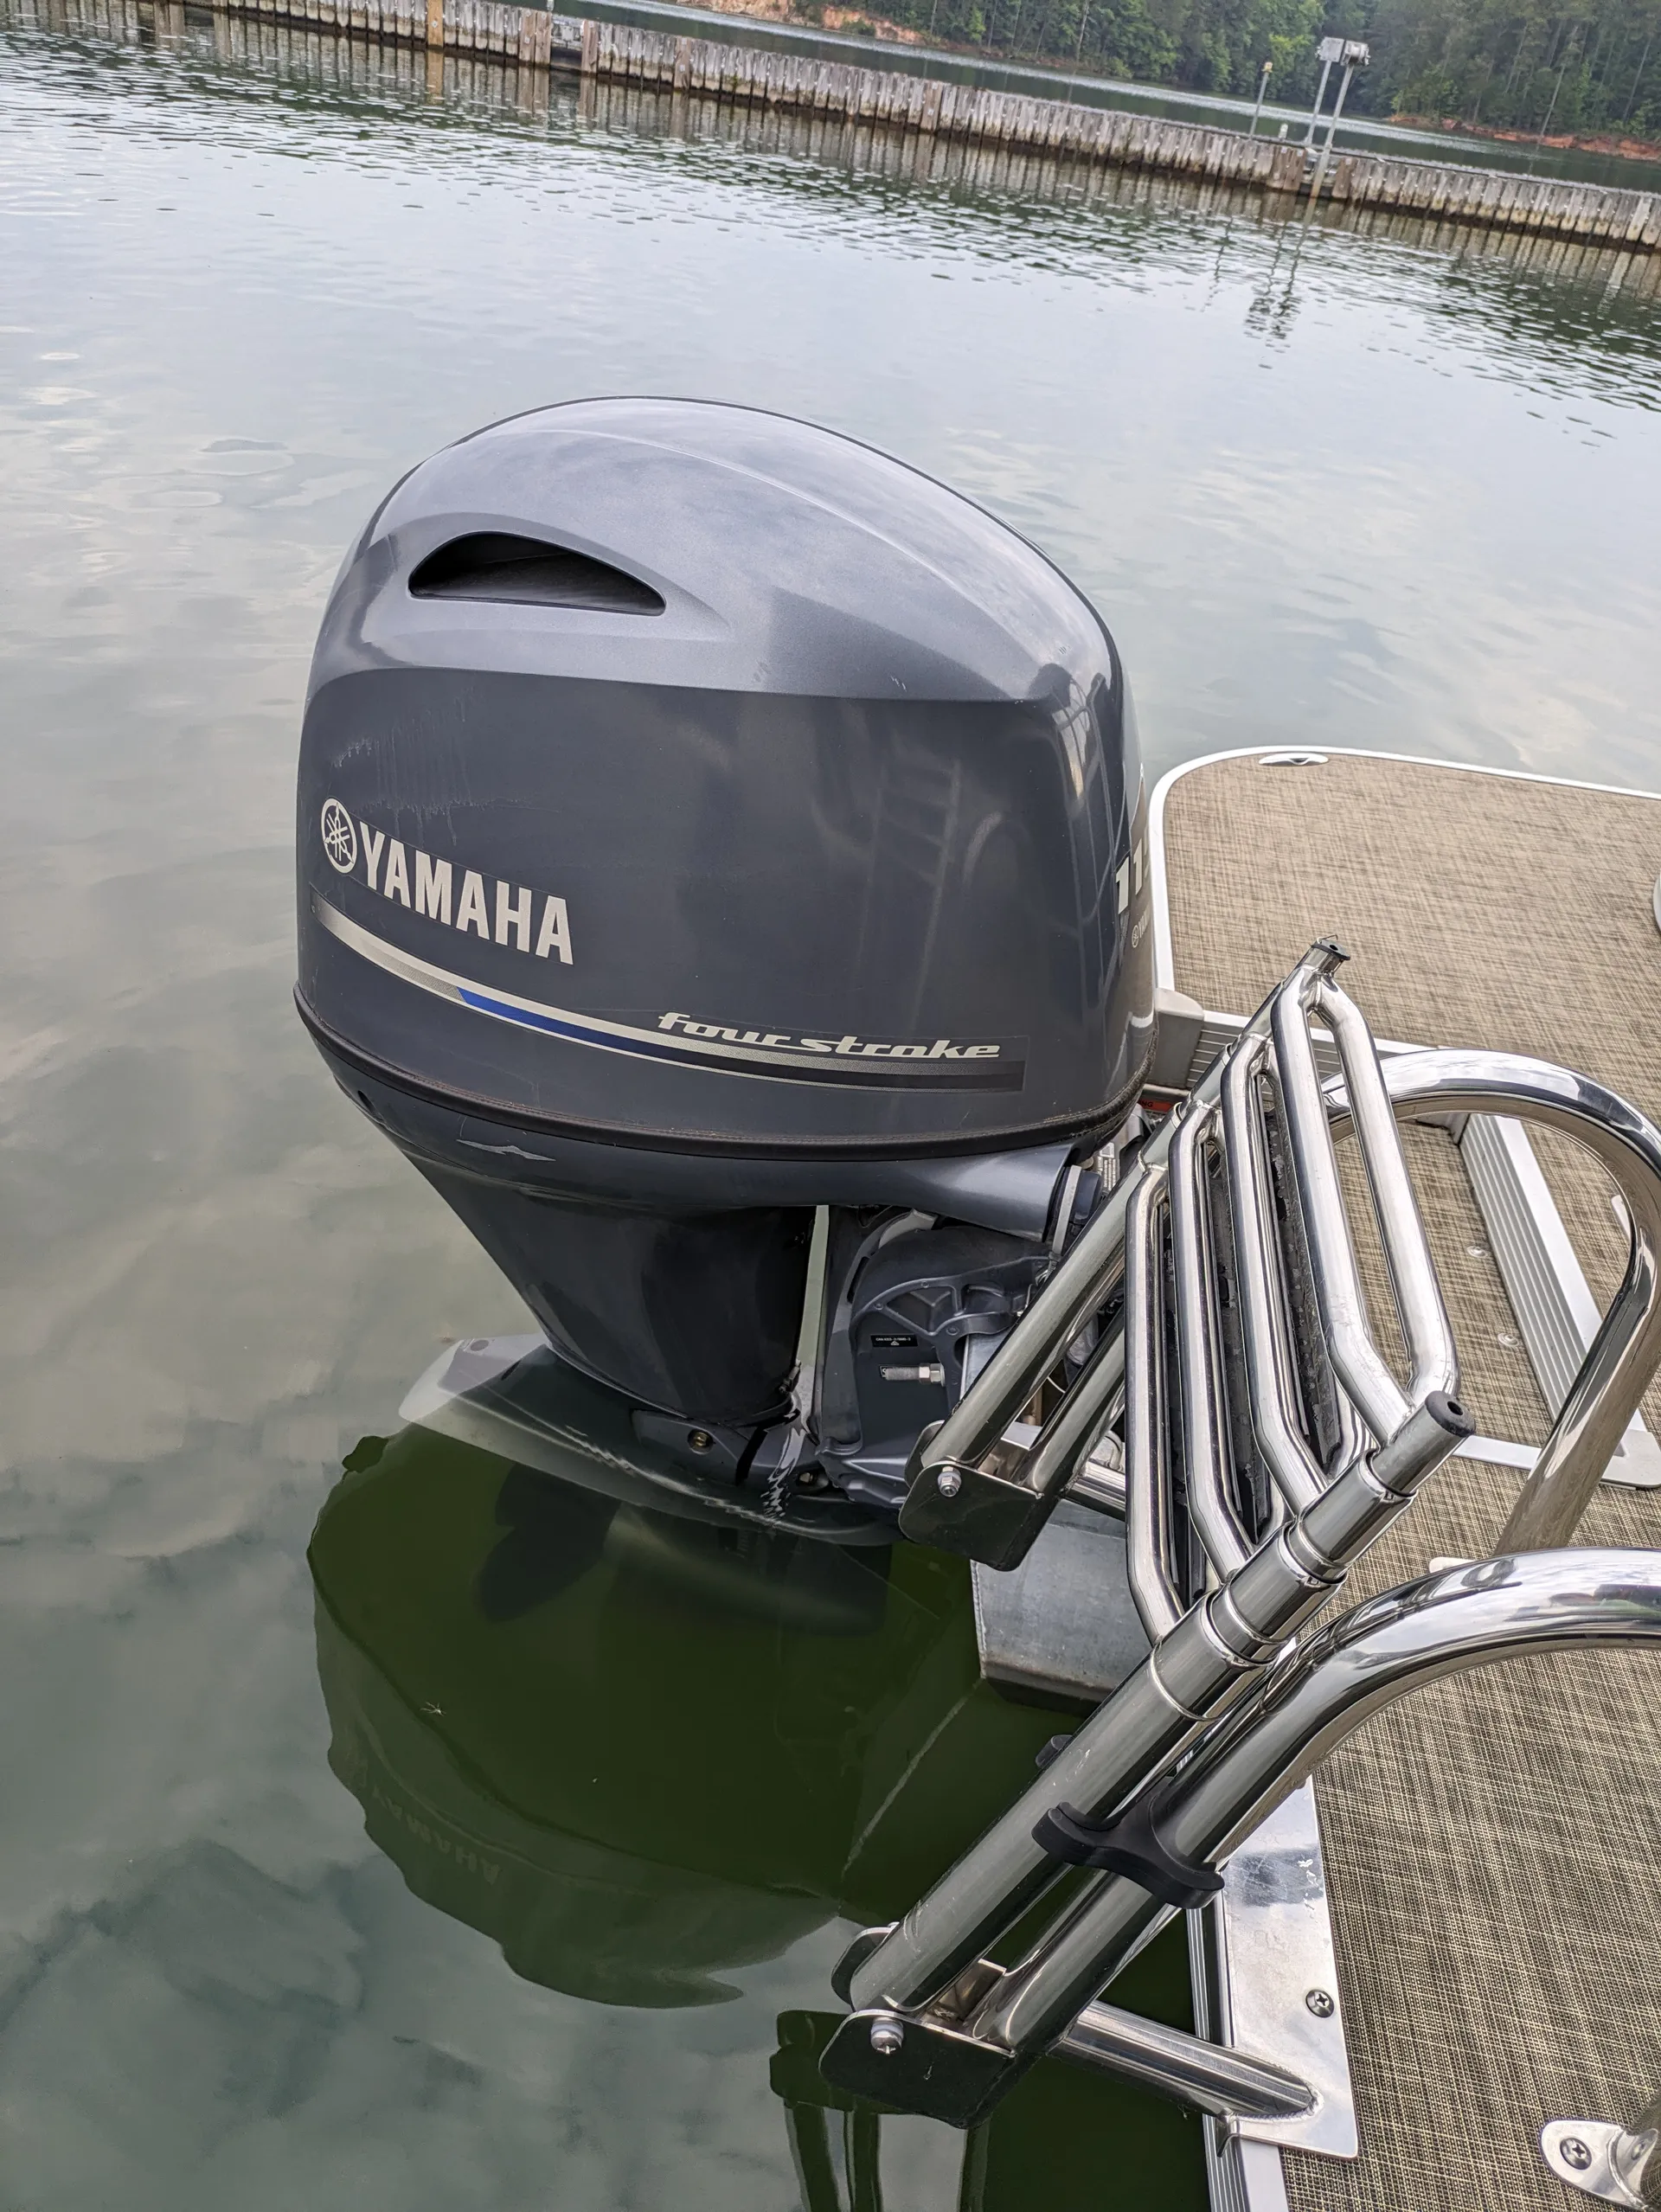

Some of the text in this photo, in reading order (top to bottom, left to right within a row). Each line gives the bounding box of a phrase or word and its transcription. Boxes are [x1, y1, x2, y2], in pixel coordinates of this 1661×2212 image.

[360, 820, 574, 965] YAMAHA
[658, 1011, 1000, 1059] four stroke
